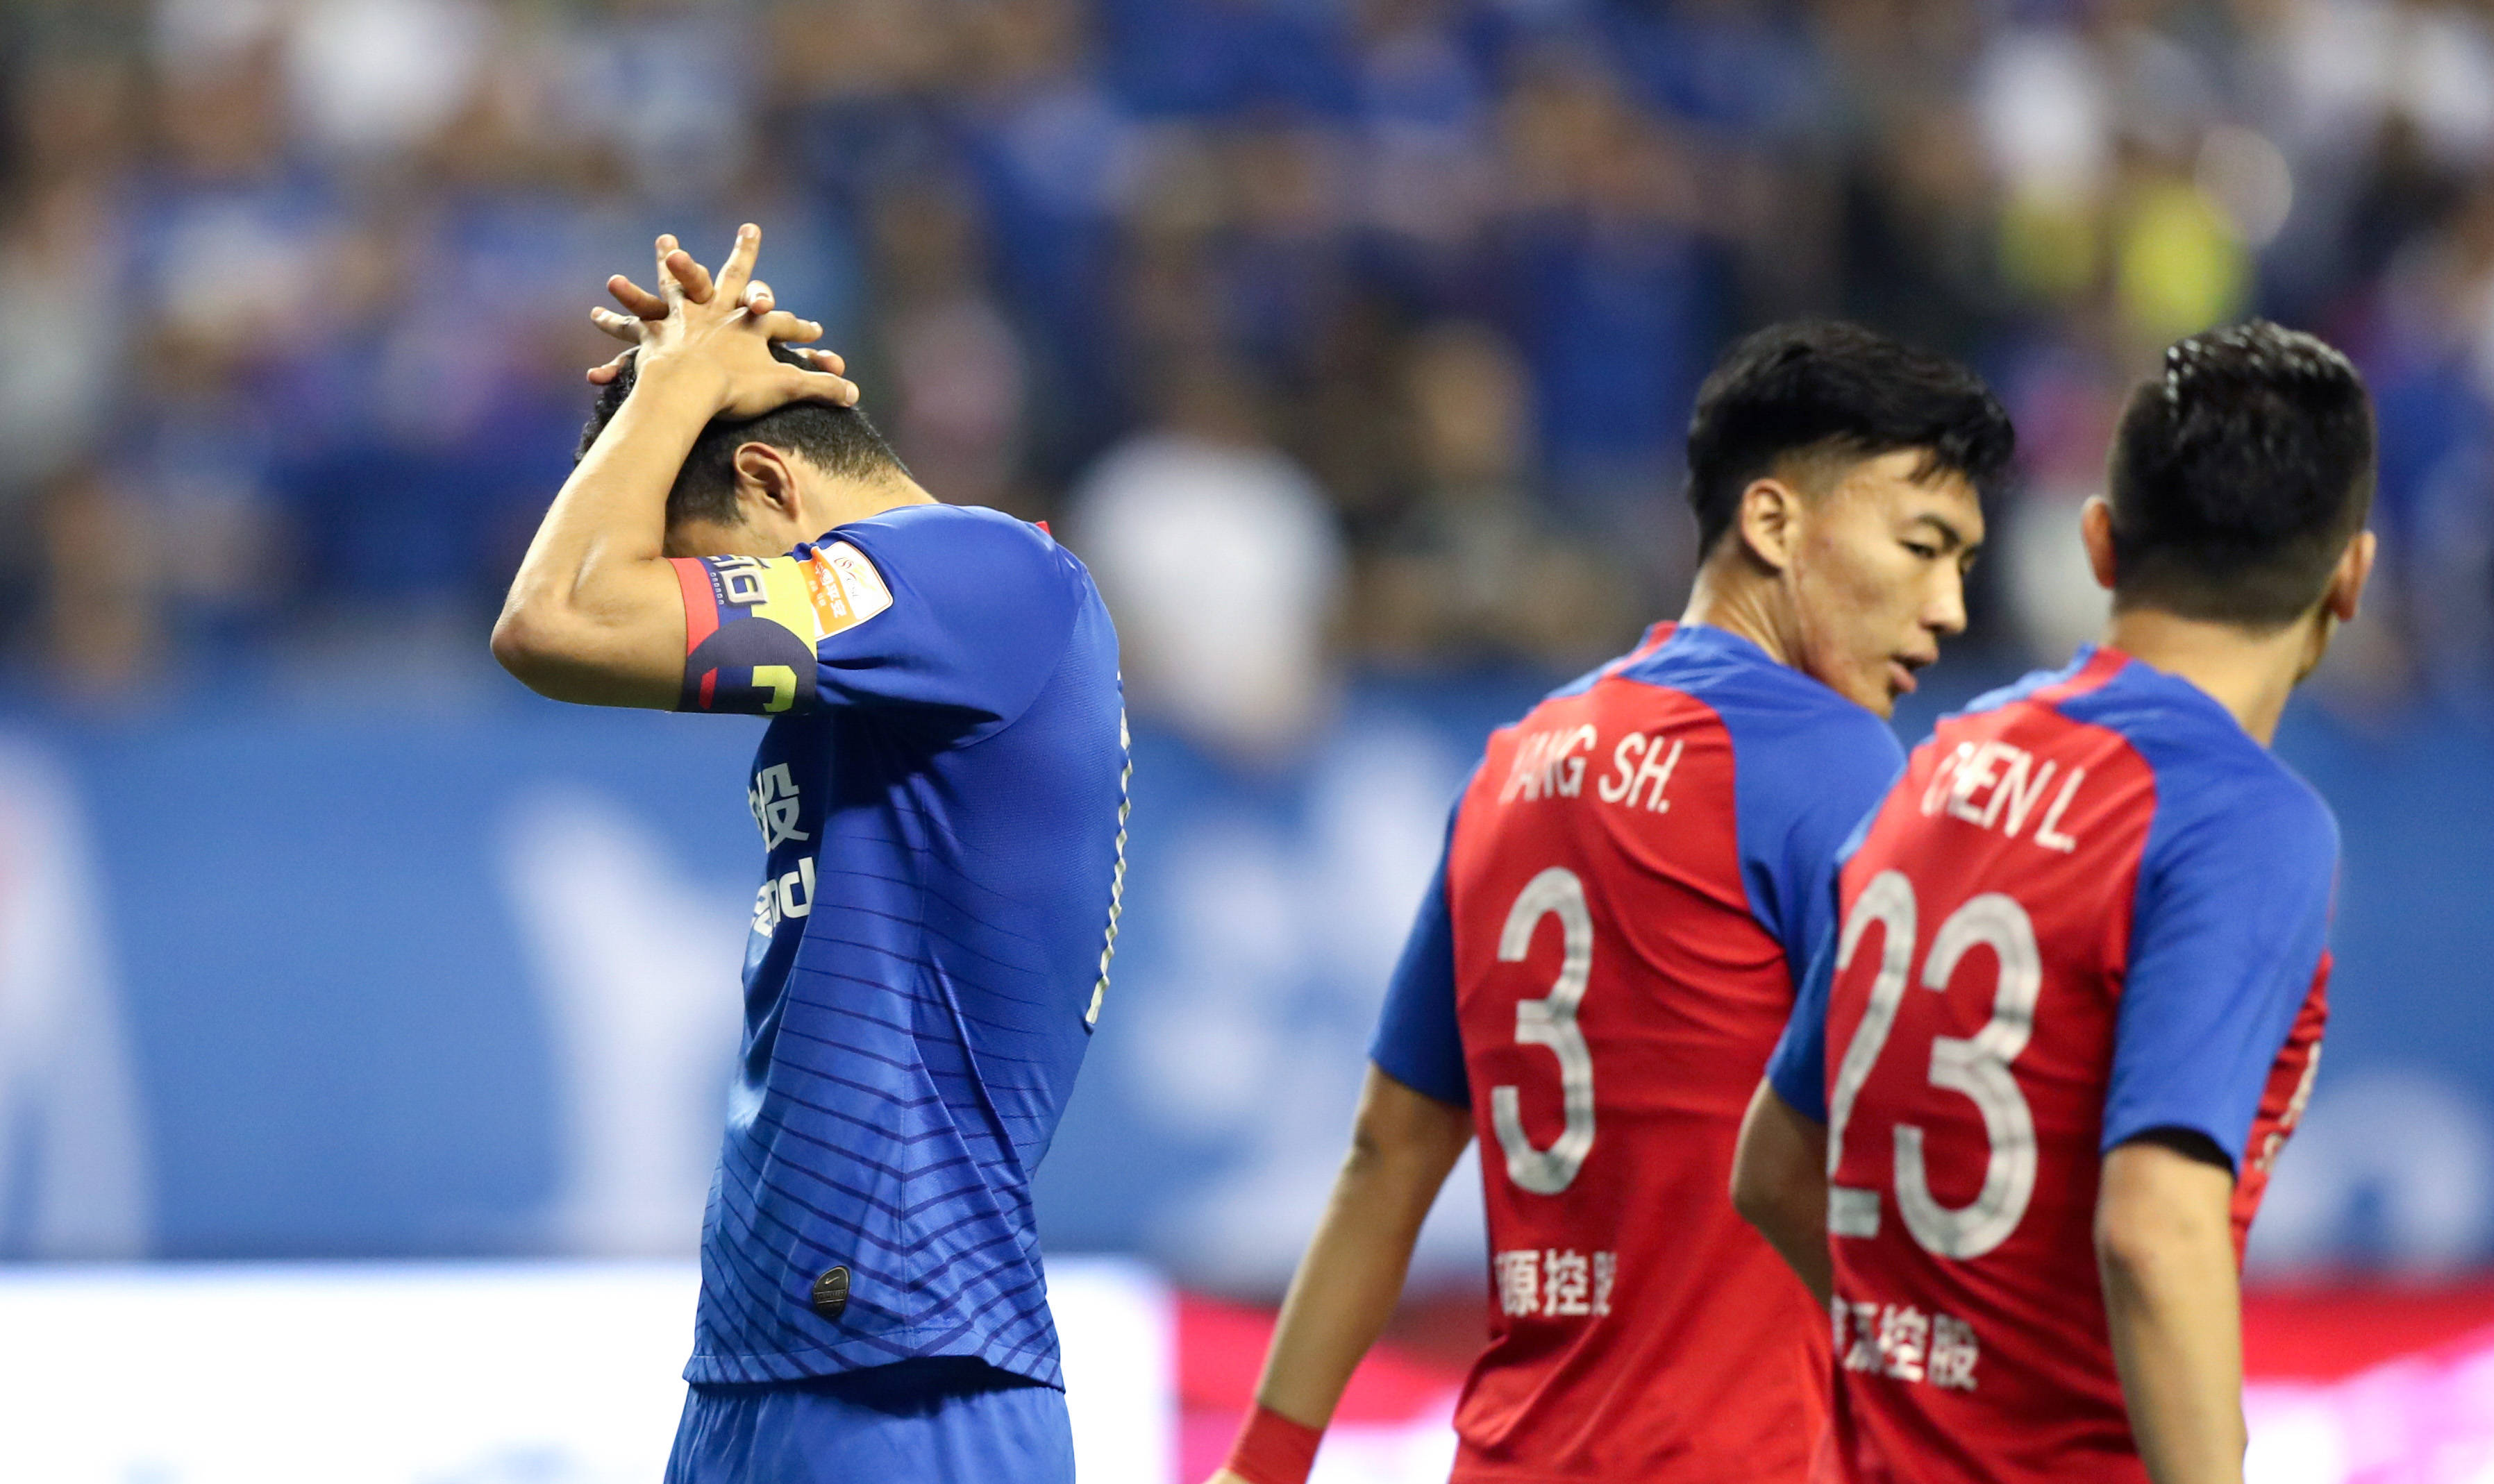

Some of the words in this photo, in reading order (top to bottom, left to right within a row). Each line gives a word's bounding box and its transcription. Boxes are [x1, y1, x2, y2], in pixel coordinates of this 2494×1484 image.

[1598, 732, 1684, 814] SH.
[1491, 866, 1596, 1196] 3
[1825, 869, 2042, 1260] 23
